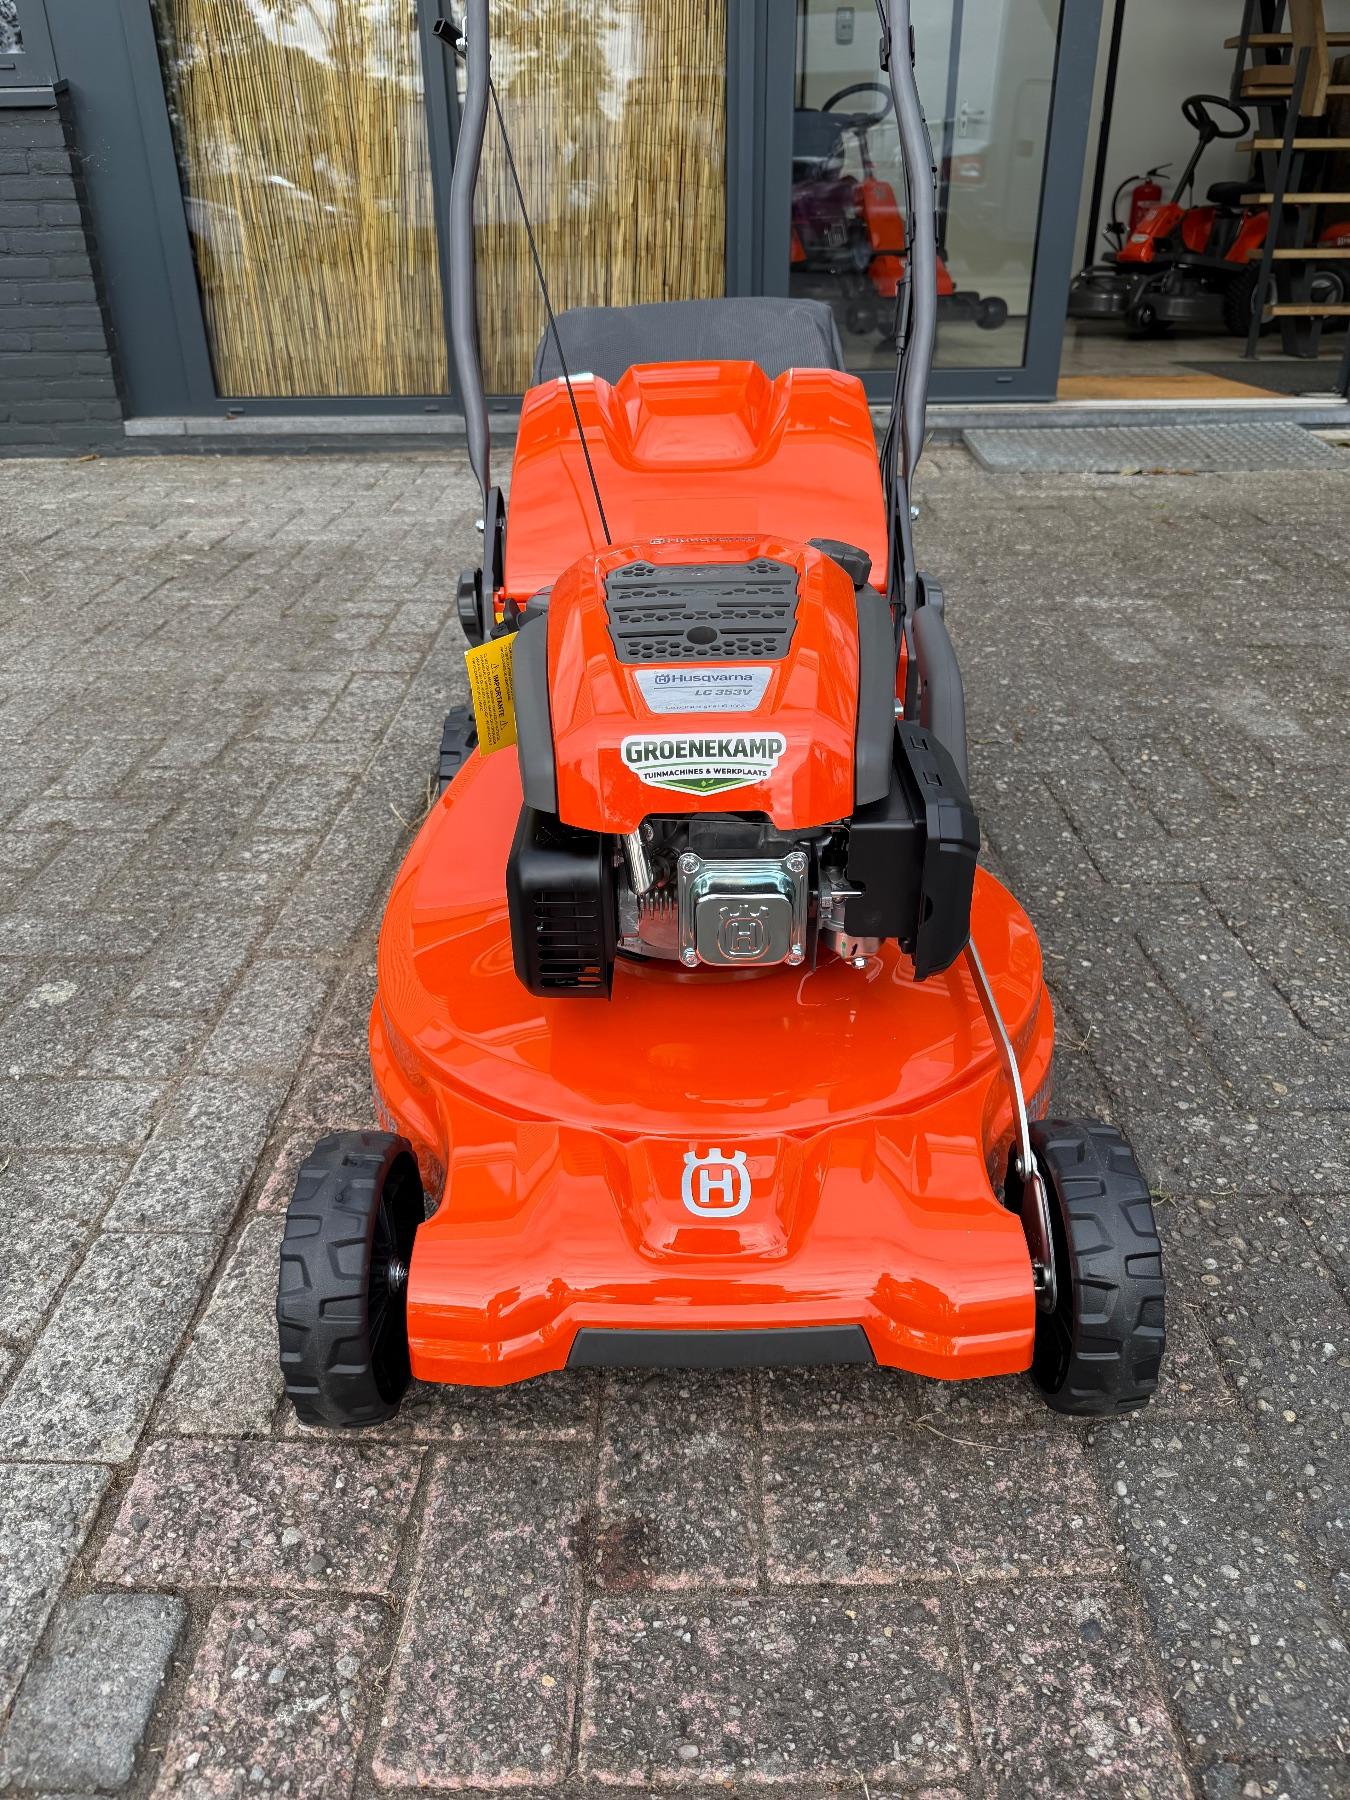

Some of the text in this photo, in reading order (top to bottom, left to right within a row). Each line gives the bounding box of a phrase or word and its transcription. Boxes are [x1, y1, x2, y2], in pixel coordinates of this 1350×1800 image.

[672, 674, 753, 683] Husqvarna
[492, 674, 505, 717] IMPORTANTE
[625, 738, 783, 764] GROENEKAMP
[643, 768, 704, 780] TUINMACHINES
[713, 768, 767, 777] WERKPLAATS
